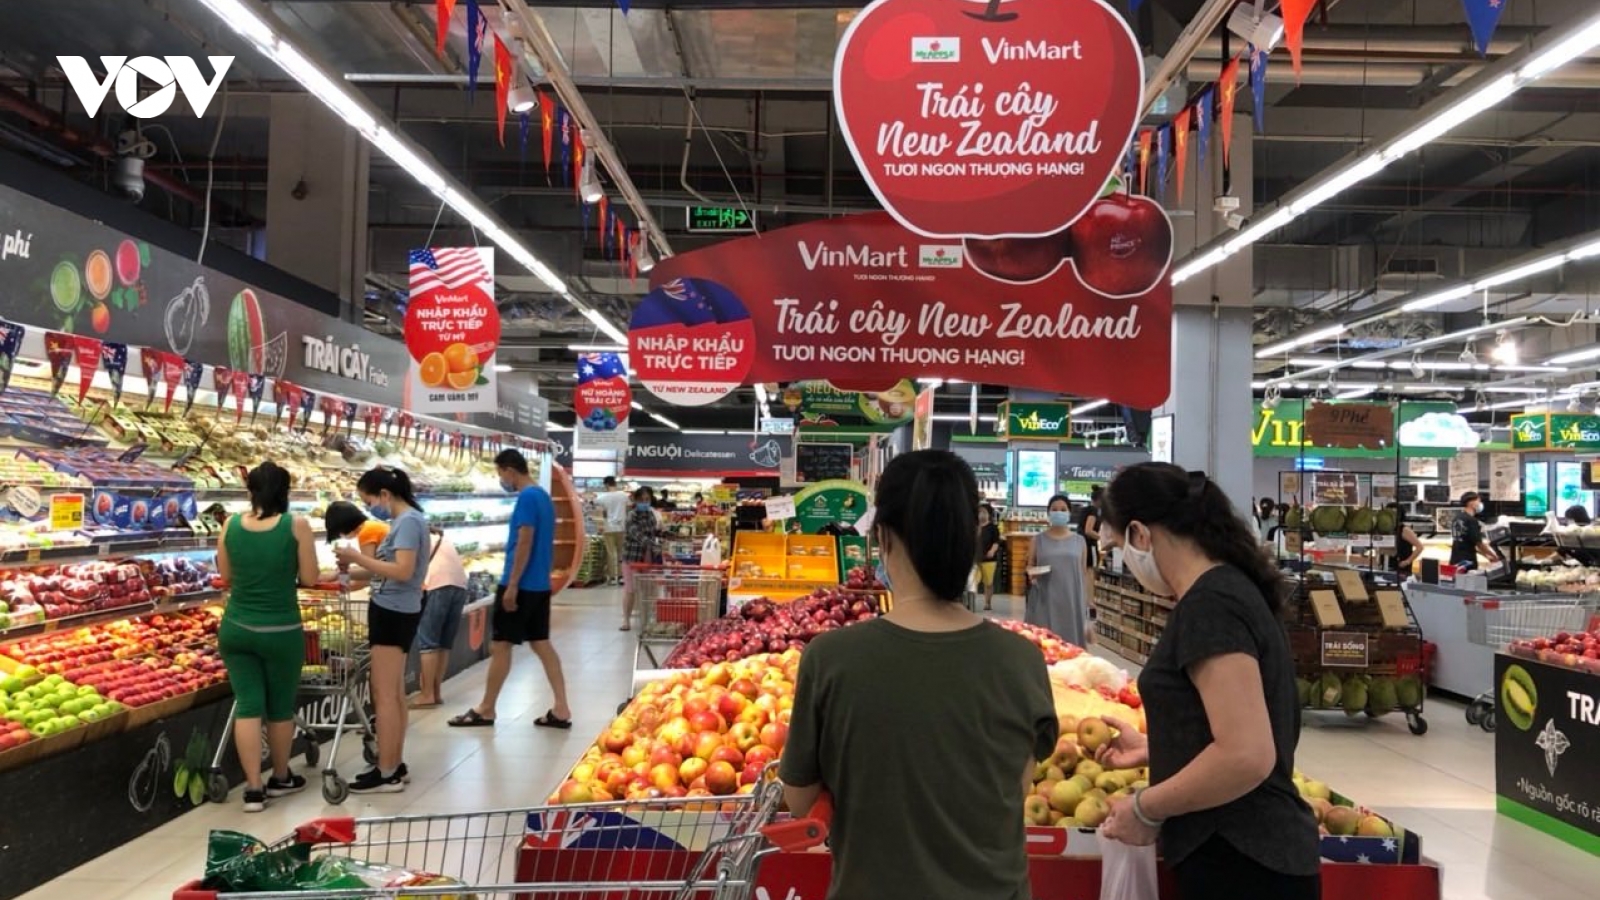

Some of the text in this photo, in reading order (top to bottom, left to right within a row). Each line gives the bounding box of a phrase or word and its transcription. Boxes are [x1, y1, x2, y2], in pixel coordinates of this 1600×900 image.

[981, 37, 1082, 64] VinMart
[916, 82, 1058, 127] Trái cây
[877, 120, 1102, 157] New Zealand
[922, 163, 966, 177] NGON
[1037, 162, 1084, 179] HẠNG!
[798, 241, 908, 271] VinMart
[773, 299, 1142, 346] Trái cây New Zealand
[637, 332, 744, 353] NHẬP KHẨU
[302, 335, 340, 374] TRÁI
[340, 343, 370, 382] CÂY
[643, 351, 738, 372] TRỰC TIẾP
[820, 346, 876, 363] NGON
[965, 349, 1025, 369] HẠNG!
[1020, 413, 1059, 431] VinEco
[1560, 426, 1600, 442] VinEco
[684, 449, 736, 459] Delicatessen
[1556, 793, 1576, 812] gốc
